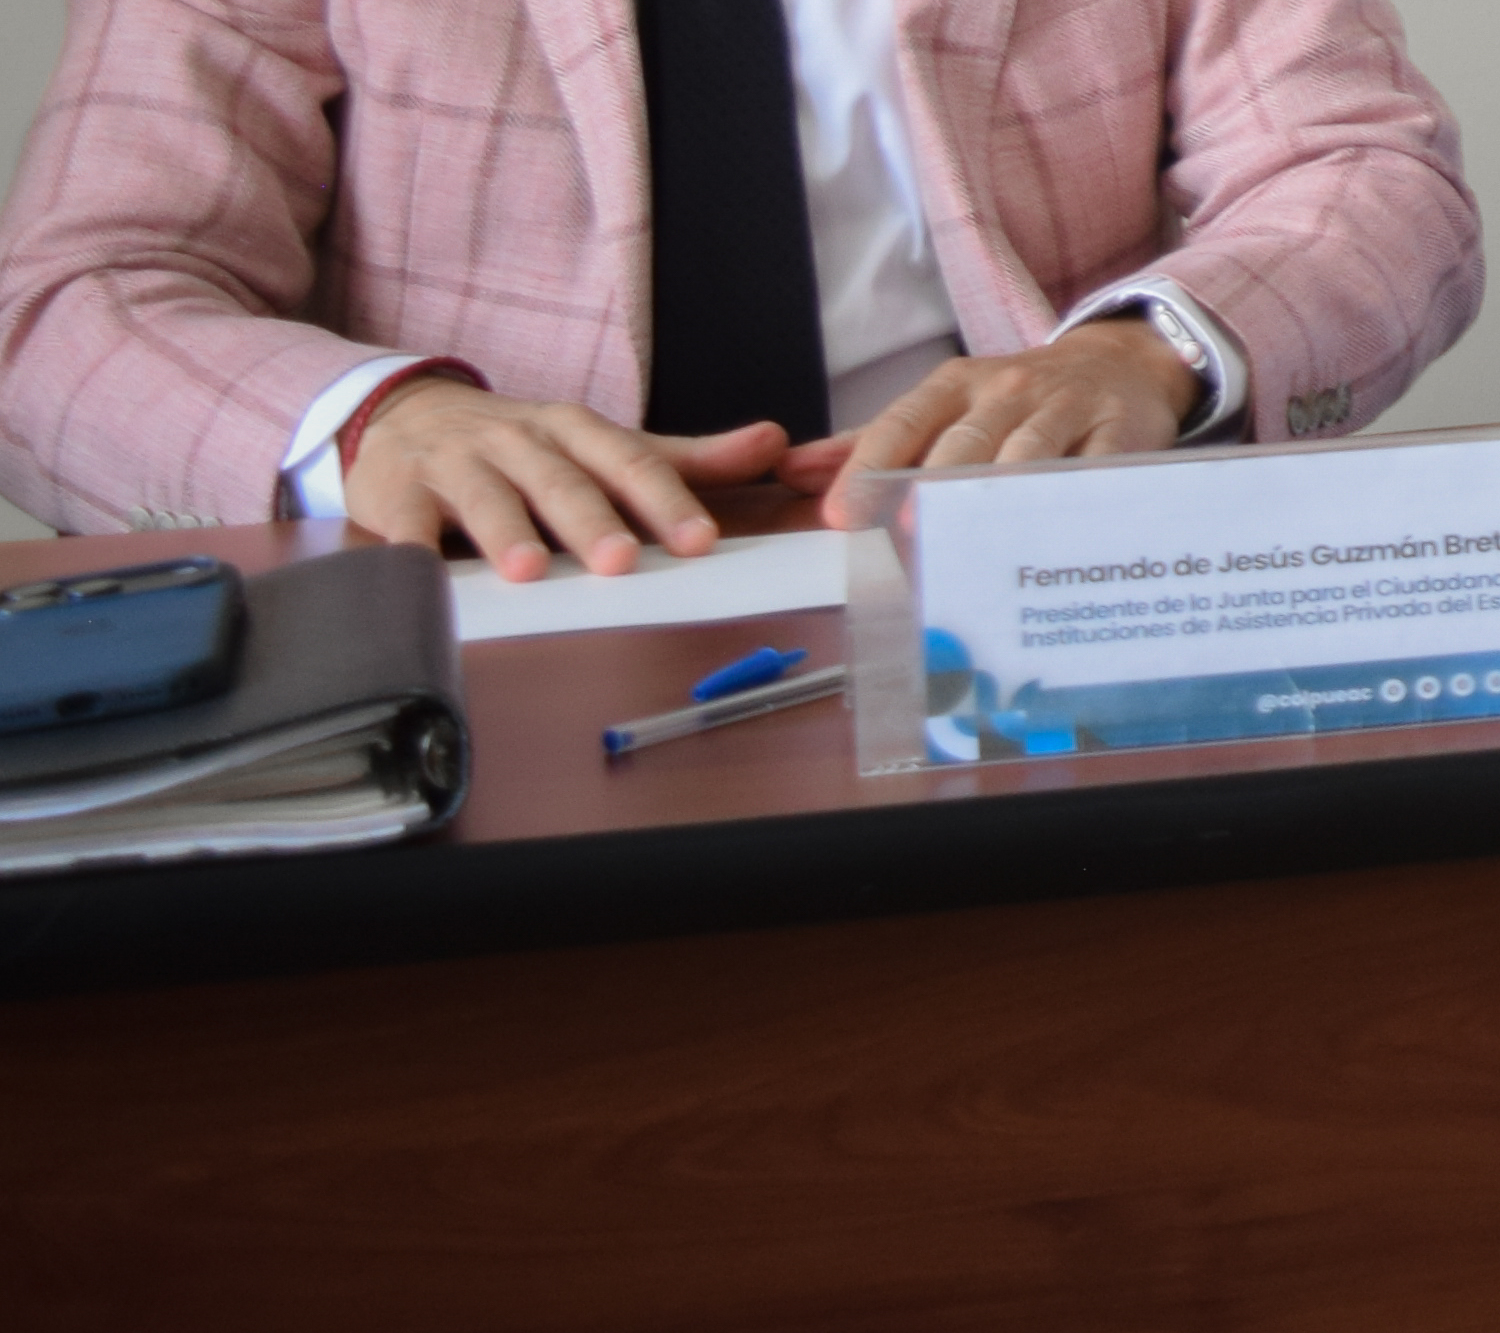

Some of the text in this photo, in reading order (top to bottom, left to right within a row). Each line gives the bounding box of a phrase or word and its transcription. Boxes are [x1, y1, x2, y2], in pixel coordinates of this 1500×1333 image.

[1017, 557, 1166, 588] Fernando
[1173, 554, 1212, 576] de
[1218, 544, 1304, 573] Jesús
[1311, 535, 1438, 565] Guzmán
[1021, 599, 1148, 625] Presidente
[1153, 596, 1185, 616] de
[1190, 593, 1212, 612] la
[1217, 590, 1284, 610] Junta
[1290, 585, 1345, 608] para
[1351, 581, 1371, 599] el
[1021, 621, 1175, 648] Instituciones
[1180, 617, 1211, 635] de
[1216, 607, 1337, 633] Asistencia
[1342, 599, 1432, 623] Privada
[1437, 594, 1473, 614] del
